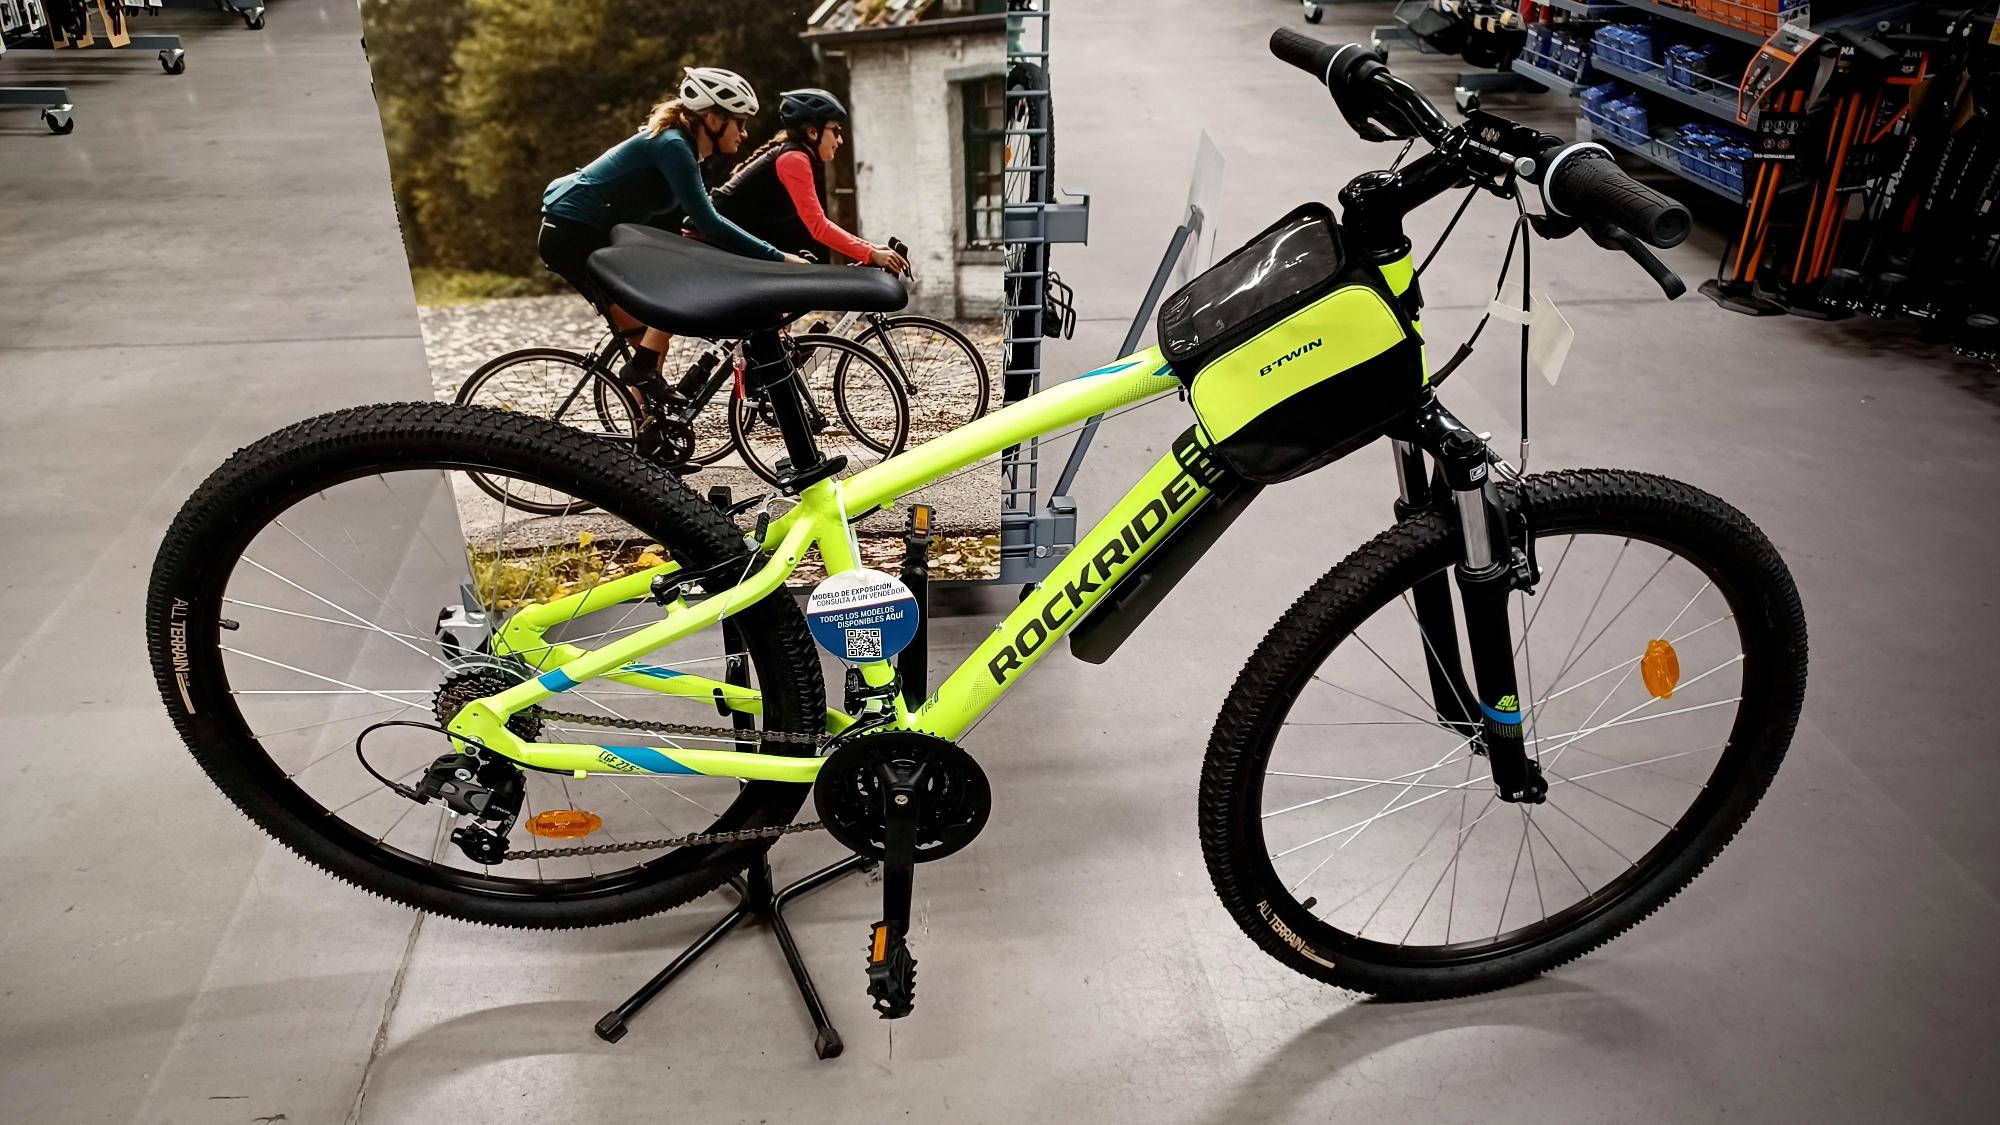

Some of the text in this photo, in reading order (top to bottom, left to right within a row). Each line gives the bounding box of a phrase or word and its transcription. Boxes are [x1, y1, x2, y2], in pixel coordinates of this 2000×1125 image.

[812, 582, 892, 601] MODELO DE EXPOSICIÓN
[816, 597, 851, 607] CONSULTA
[869, 586, 905, 599] VENDEDOR
[171, 597, 189, 619] ALL
[819, 605, 895, 624] TODOS LOS MODELOS
[837, 609, 904, 629] DISPONIBLES AQUÍ
[170, 620, 190, 672] TERRAIN
[1256, 900, 1306, 952] ALL TERRAIN
